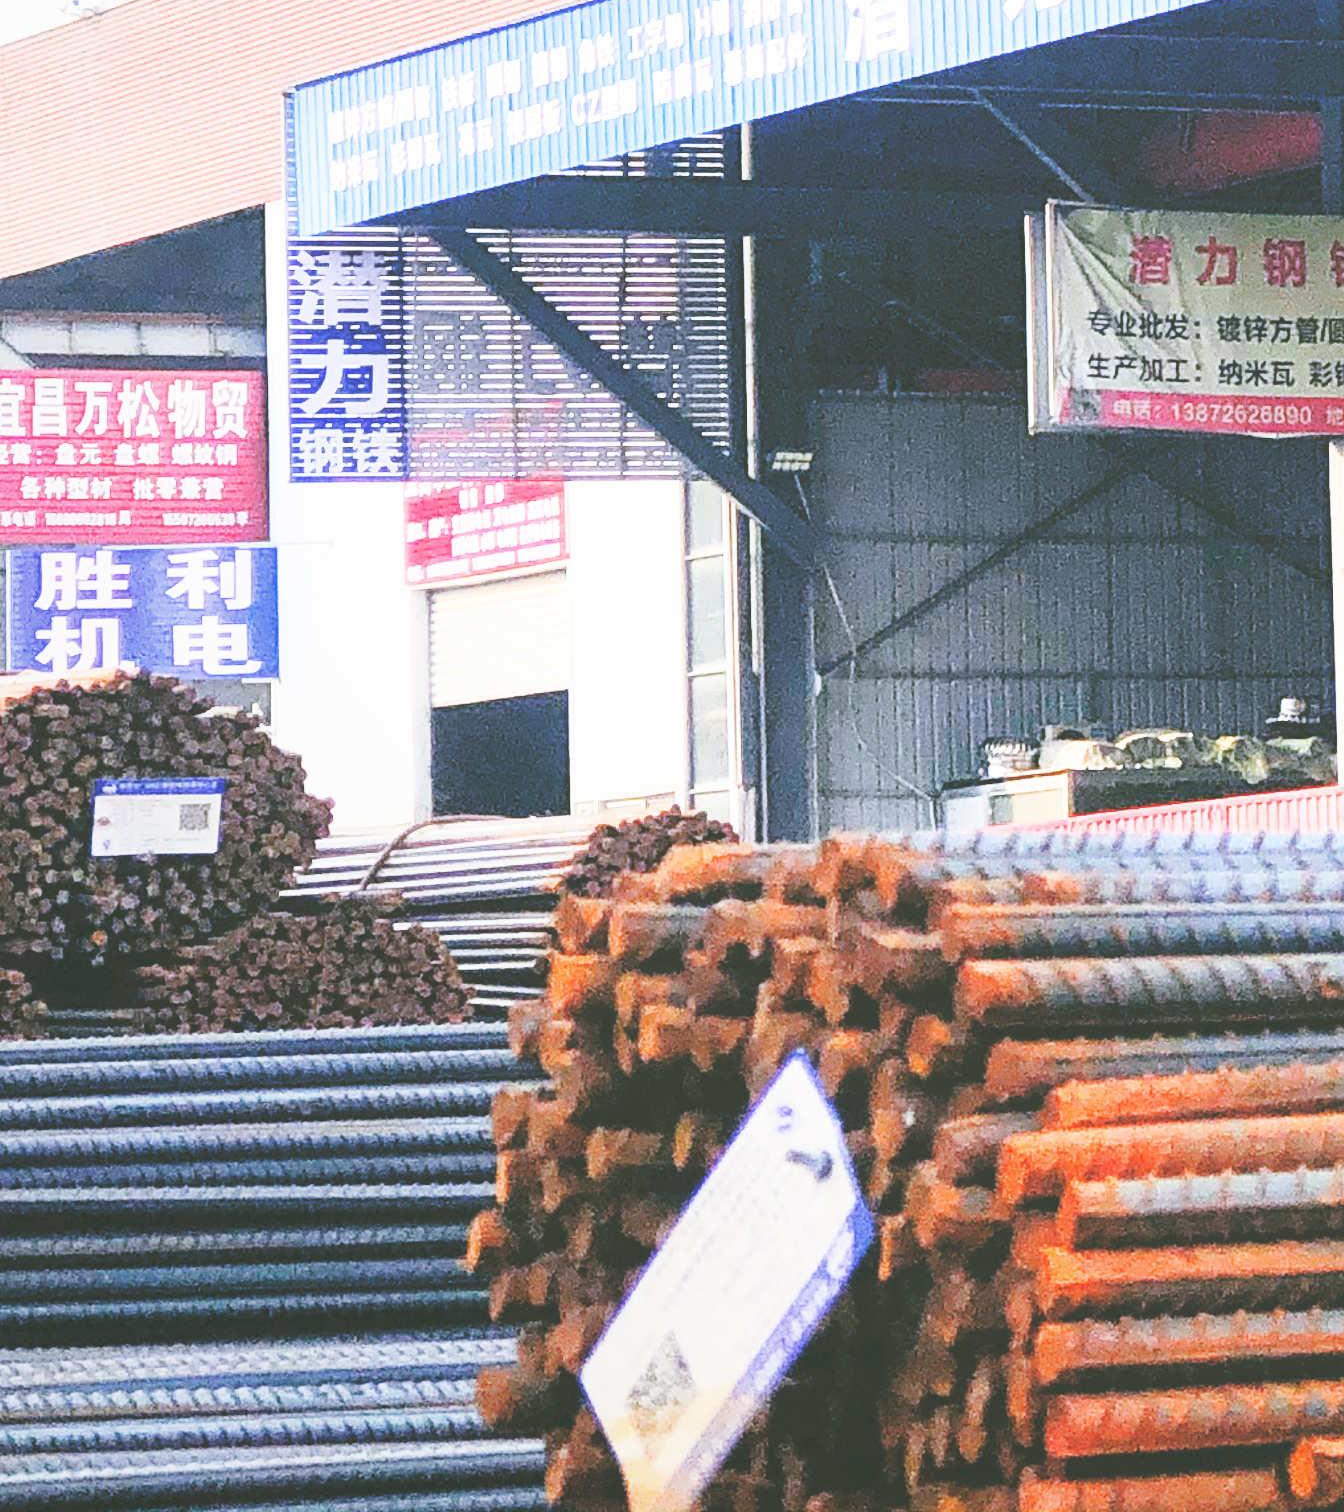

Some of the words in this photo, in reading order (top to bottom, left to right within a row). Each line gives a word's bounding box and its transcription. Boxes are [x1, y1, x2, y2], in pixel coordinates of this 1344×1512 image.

[0, 378, 248, 440] 宜昌万松物贸
[298, 428, 401, 474] 钢铁
[20, 476, 112, 501] 各种型材
[34, 549, 254, 611] 胜利
[35, 615, 263, 675] 机电
